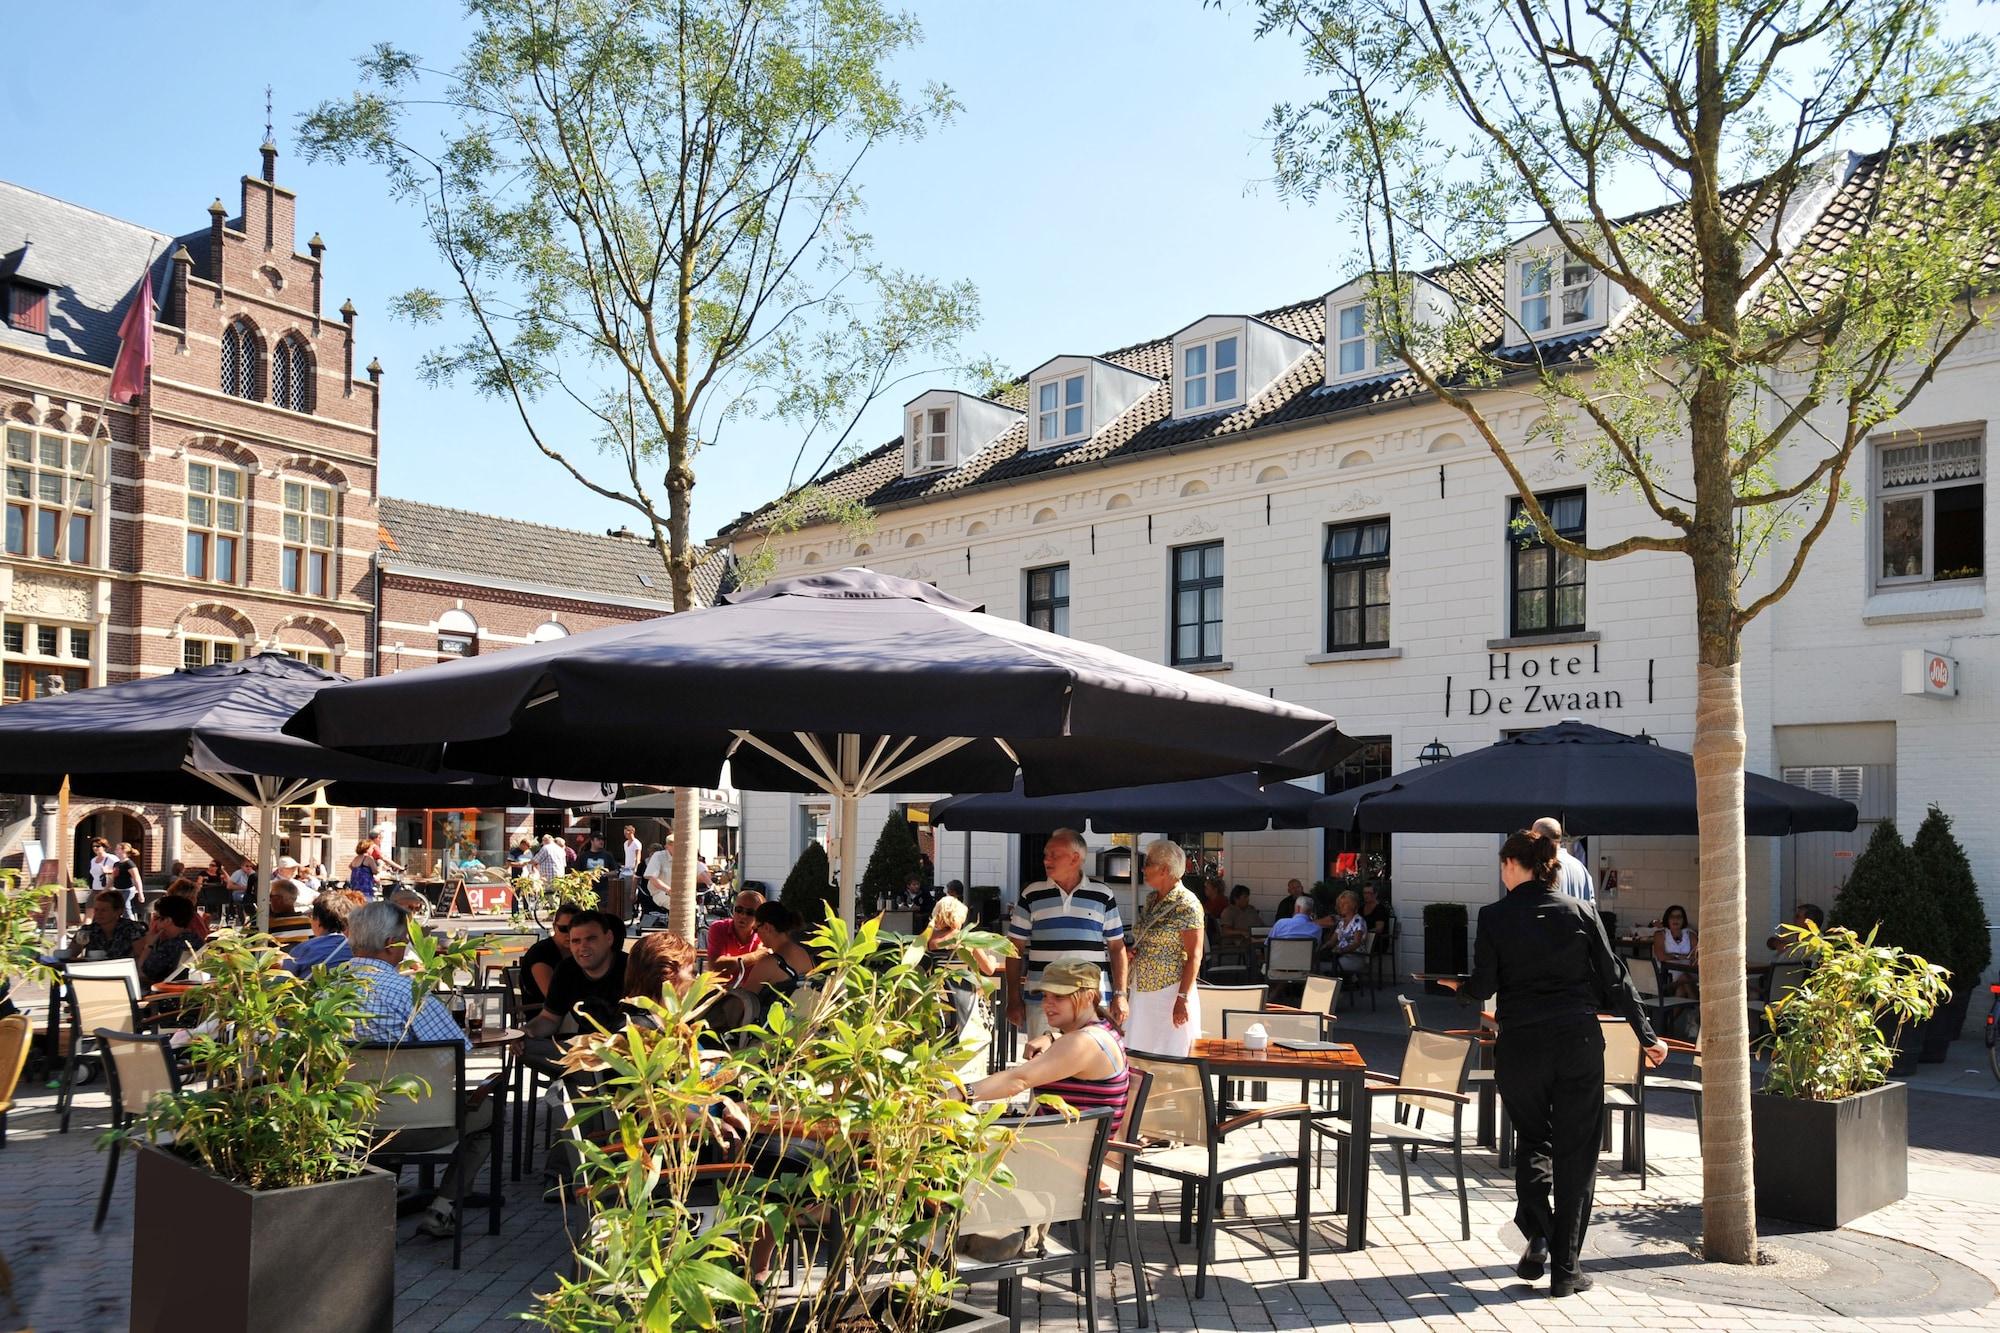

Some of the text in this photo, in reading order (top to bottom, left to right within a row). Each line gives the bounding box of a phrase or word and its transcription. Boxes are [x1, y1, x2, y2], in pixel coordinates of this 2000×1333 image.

[1488, 644, 1600, 680] Hotel
[1930, 660, 1948, 683] Jola
[1468, 685, 1623, 716] De Zwaan
